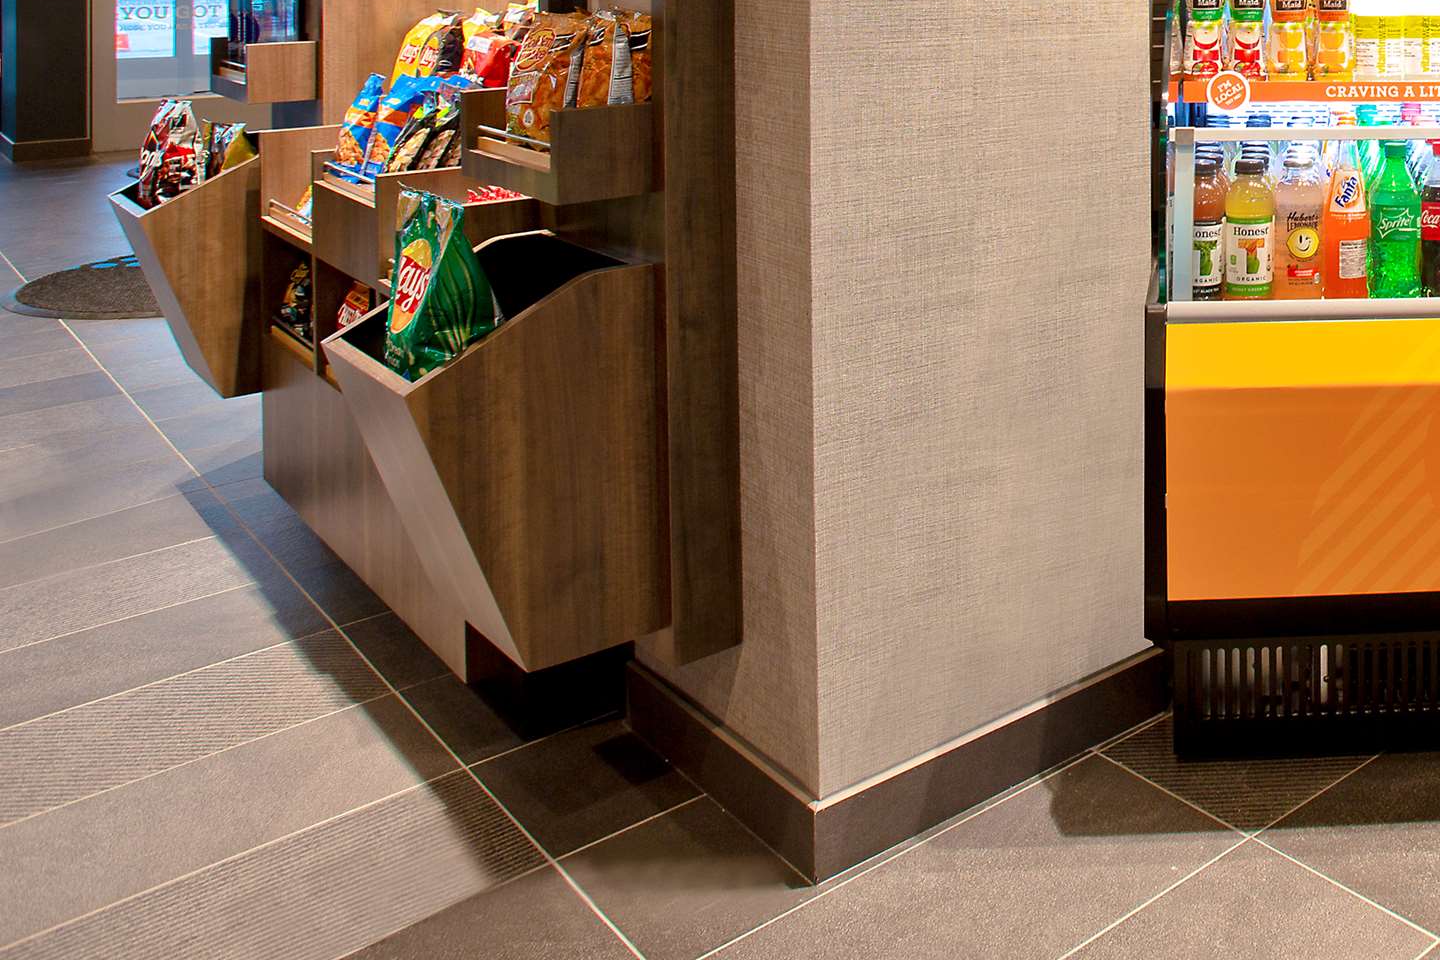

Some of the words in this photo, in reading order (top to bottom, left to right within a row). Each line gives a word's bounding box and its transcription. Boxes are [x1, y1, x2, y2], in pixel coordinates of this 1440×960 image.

[1282, 0, 1302, 8] Maid
[1323, 0, 1342, 8] Maid
[120, 6, 168, 20] YOU
[178, 4, 222, 18] GOT
[1214, 83, 1244, 105] LOCAL
[1325, 85, 1399, 97] CRAVING
[1404, 86, 1416, 97] A
[1335, 176, 1358, 208] Fanta
[1379, 215, 1410, 231] Sprite
[1195, 227, 1221, 239] onest
[1233, 226, 1269, 237] Honest
